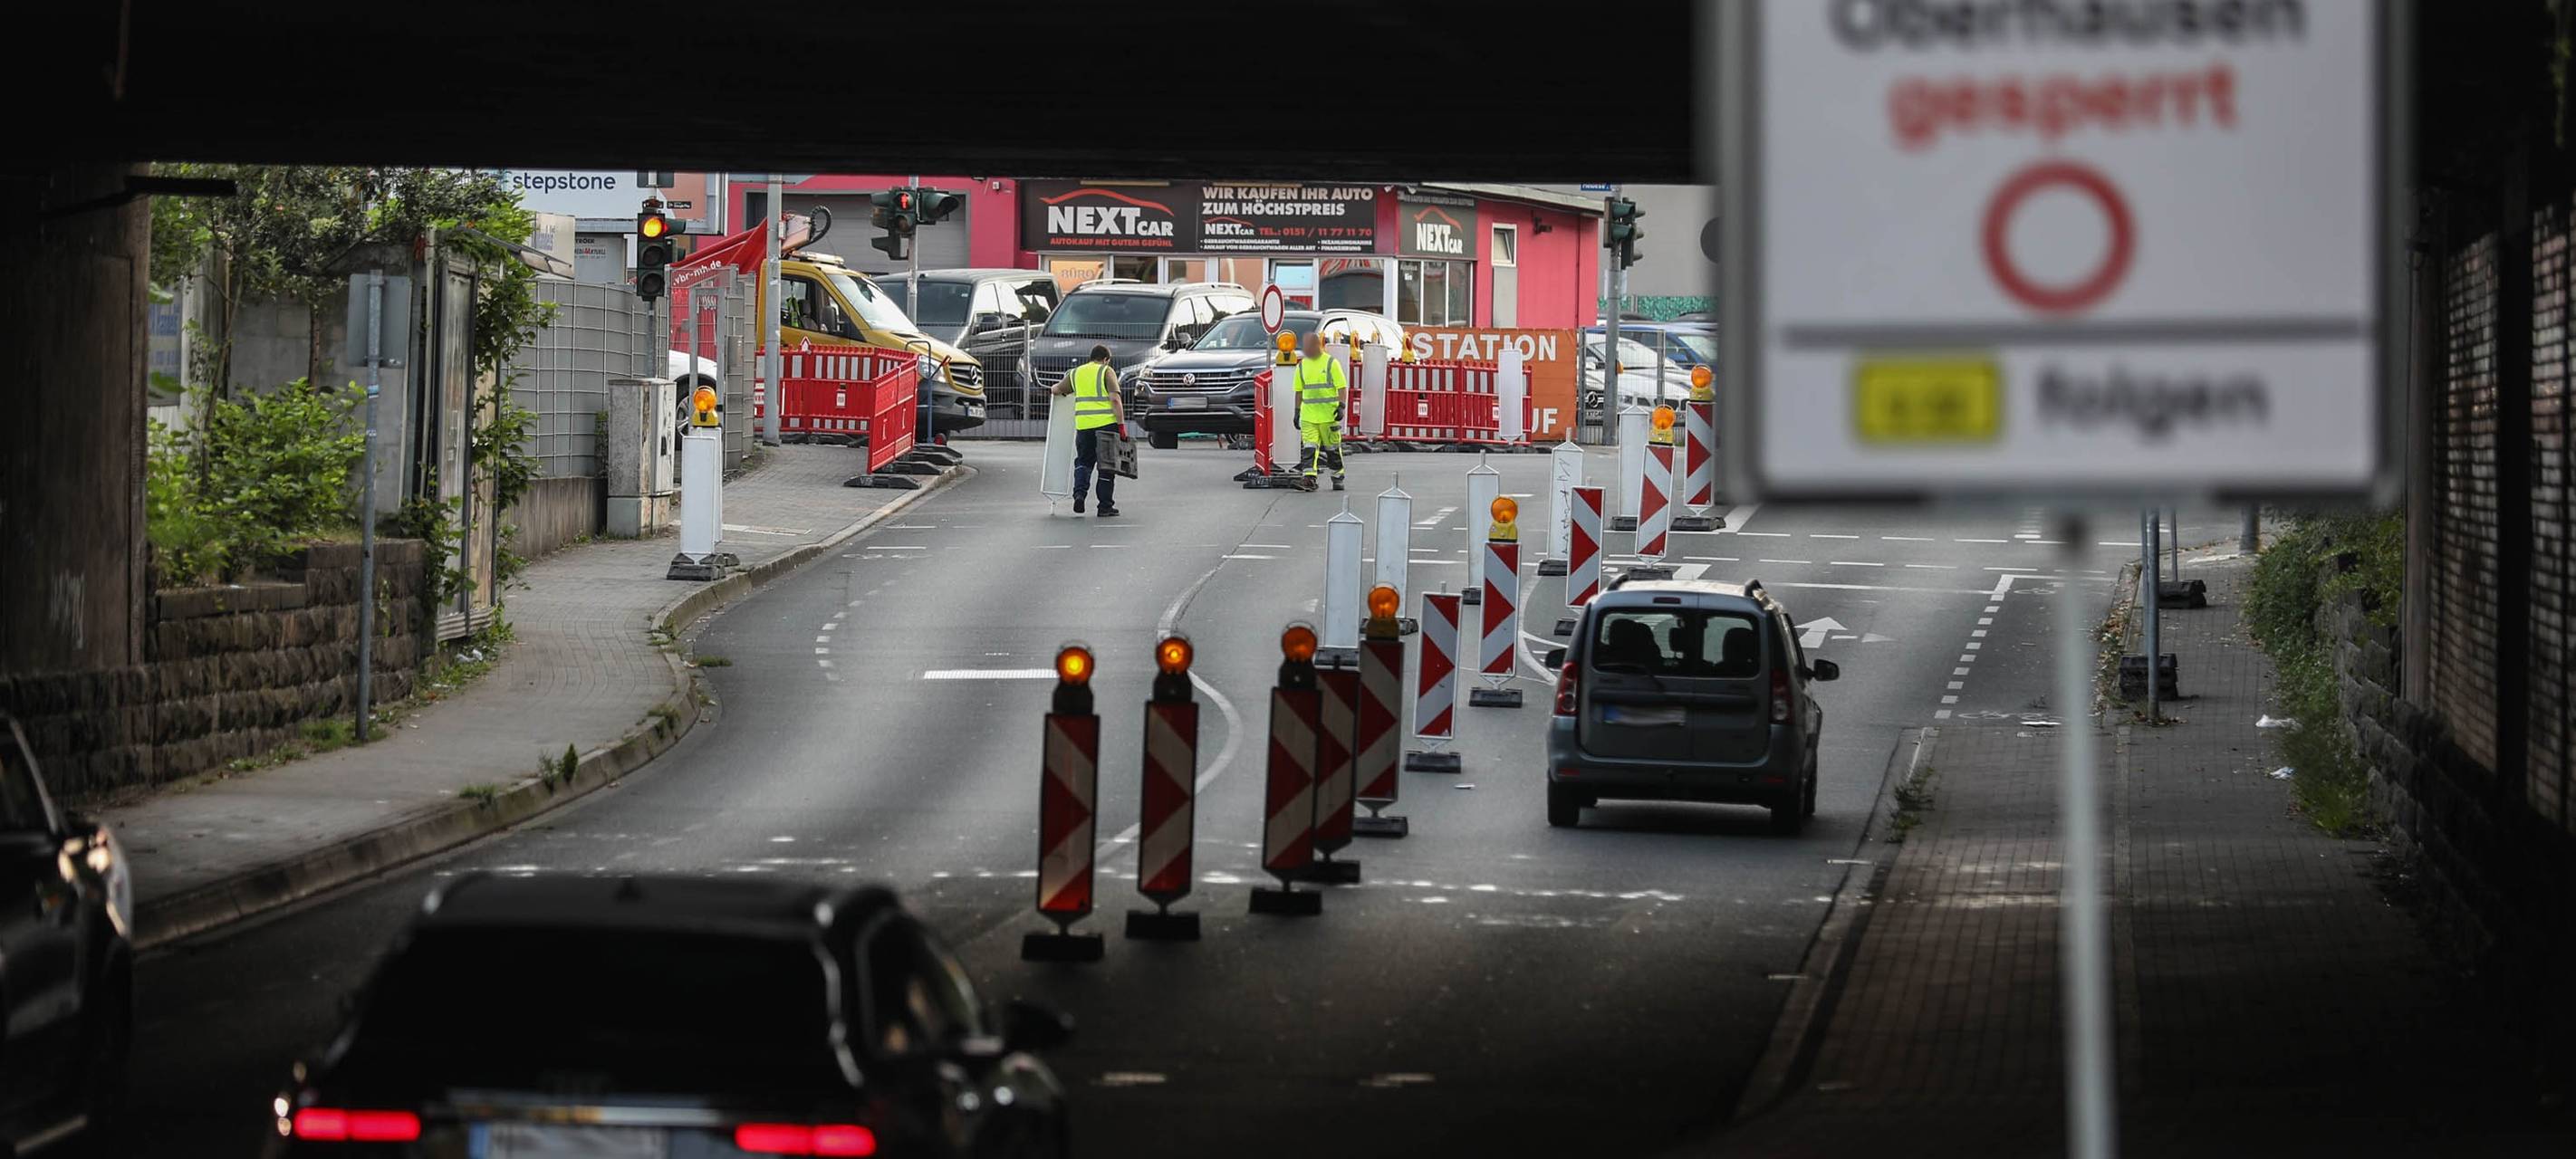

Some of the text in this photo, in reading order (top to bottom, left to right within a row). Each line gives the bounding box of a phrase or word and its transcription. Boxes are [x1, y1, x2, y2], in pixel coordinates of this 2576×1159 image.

[1889, 62, 2238, 147] gesperrt
[513, 172, 616, 194] stepstone
[1202, 187, 1373, 201] WIR KAUFEN IHR AUTO
[1202, 198, 1345, 216] ZUM HÖCHSTPREIS
[1259, 227, 1282, 235] TEL.:
[1283, 227, 1305, 236] 0151
[1331, 227, 1342, 236] 77
[1359, 227, 1372, 236] 70
[1050, 237, 1173, 247] AUTOKAUF MIT GUTEM GEFÜHL
[1412, 332, 1556, 361] STATION
